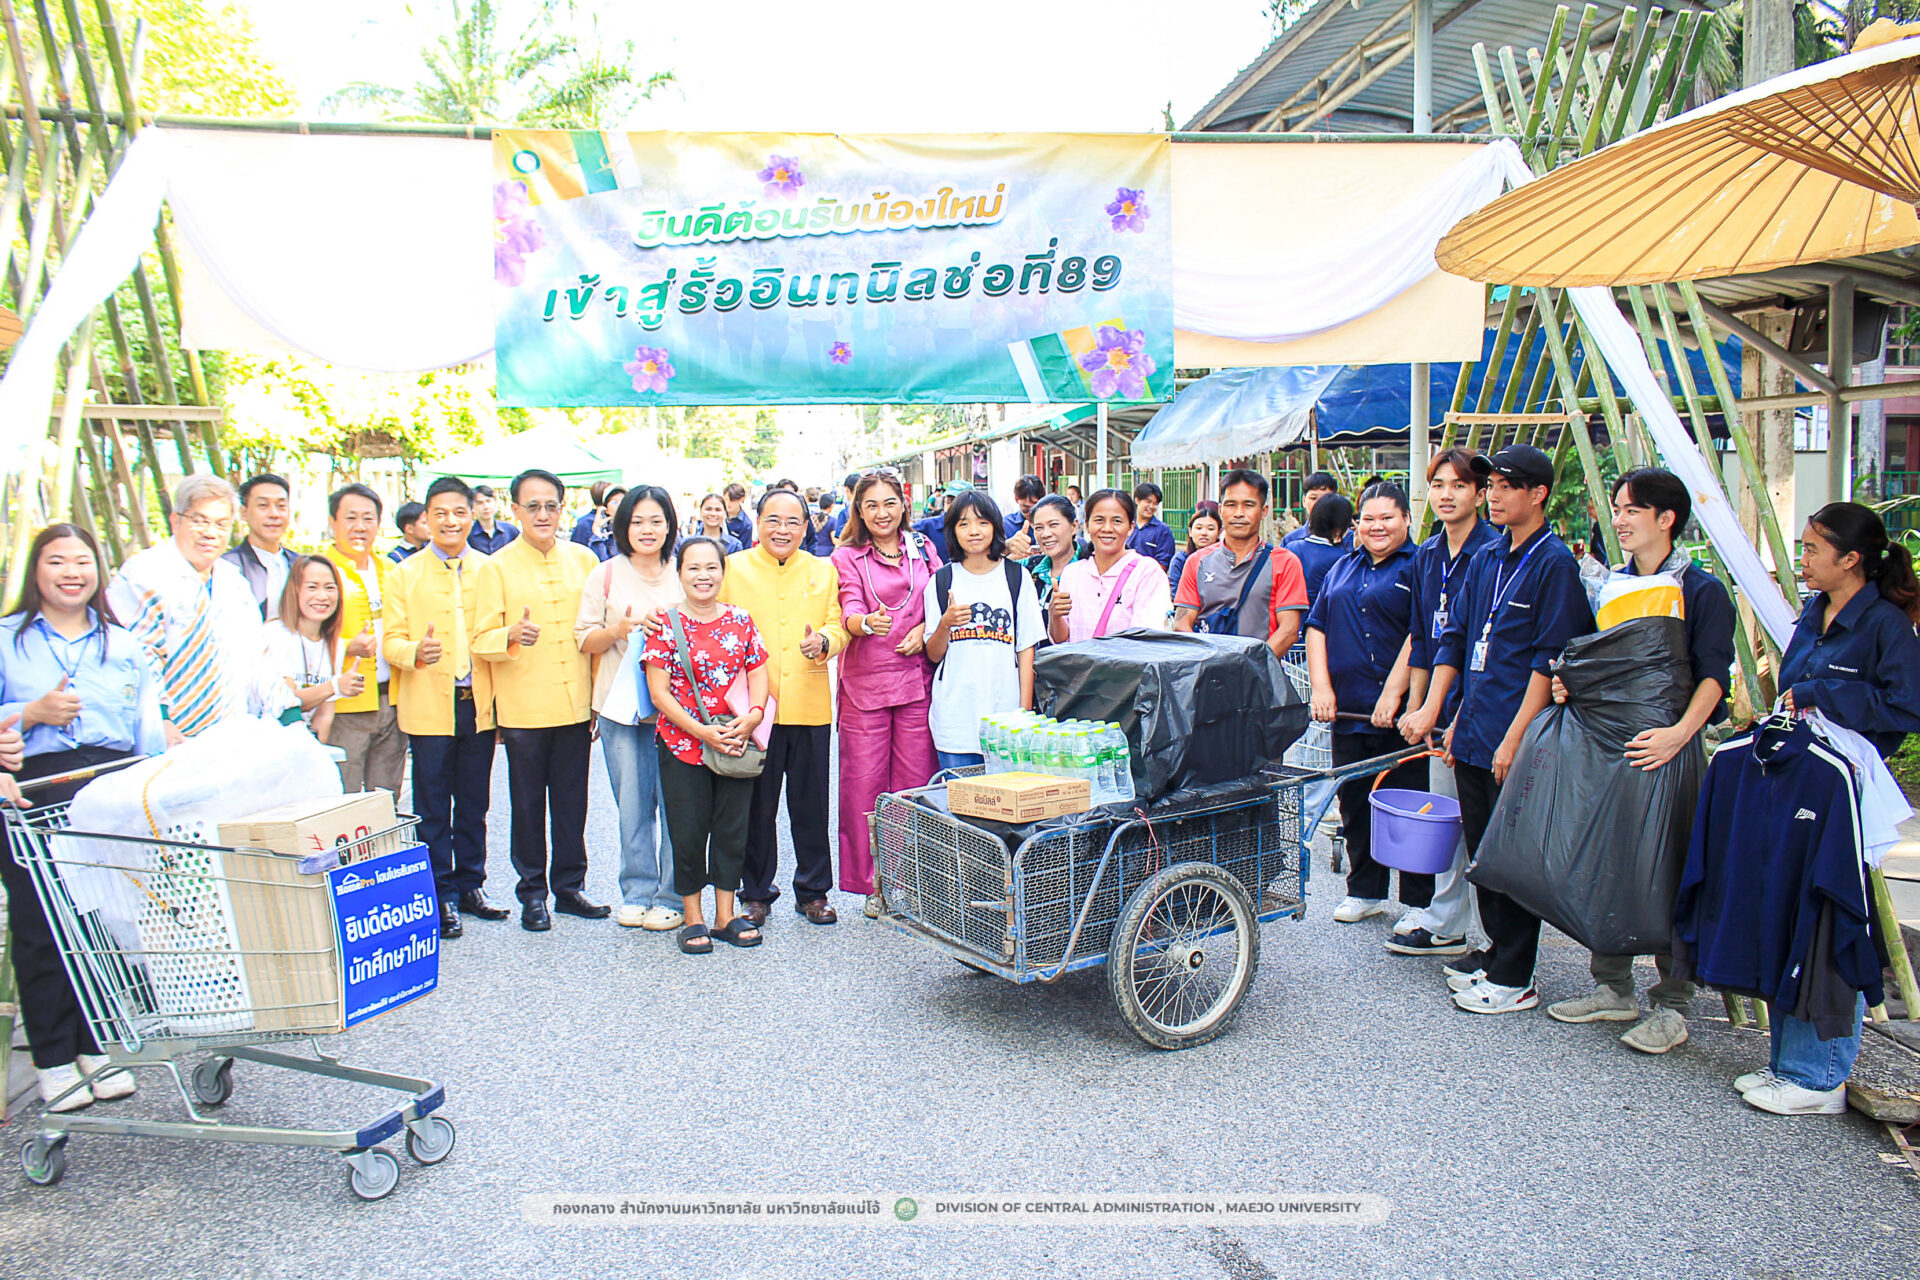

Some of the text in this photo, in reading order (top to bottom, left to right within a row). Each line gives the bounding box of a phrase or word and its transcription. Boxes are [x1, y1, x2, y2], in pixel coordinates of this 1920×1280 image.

[637, 183, 1004, 241] ยินดีต้อนรับน้องใหม่
[335, 877, 375, 896] HomePro
[345, 893, 434, 943] ยินดีต้อนรับ
[349, 928, 437, 985] นักศึกษาใหม่
